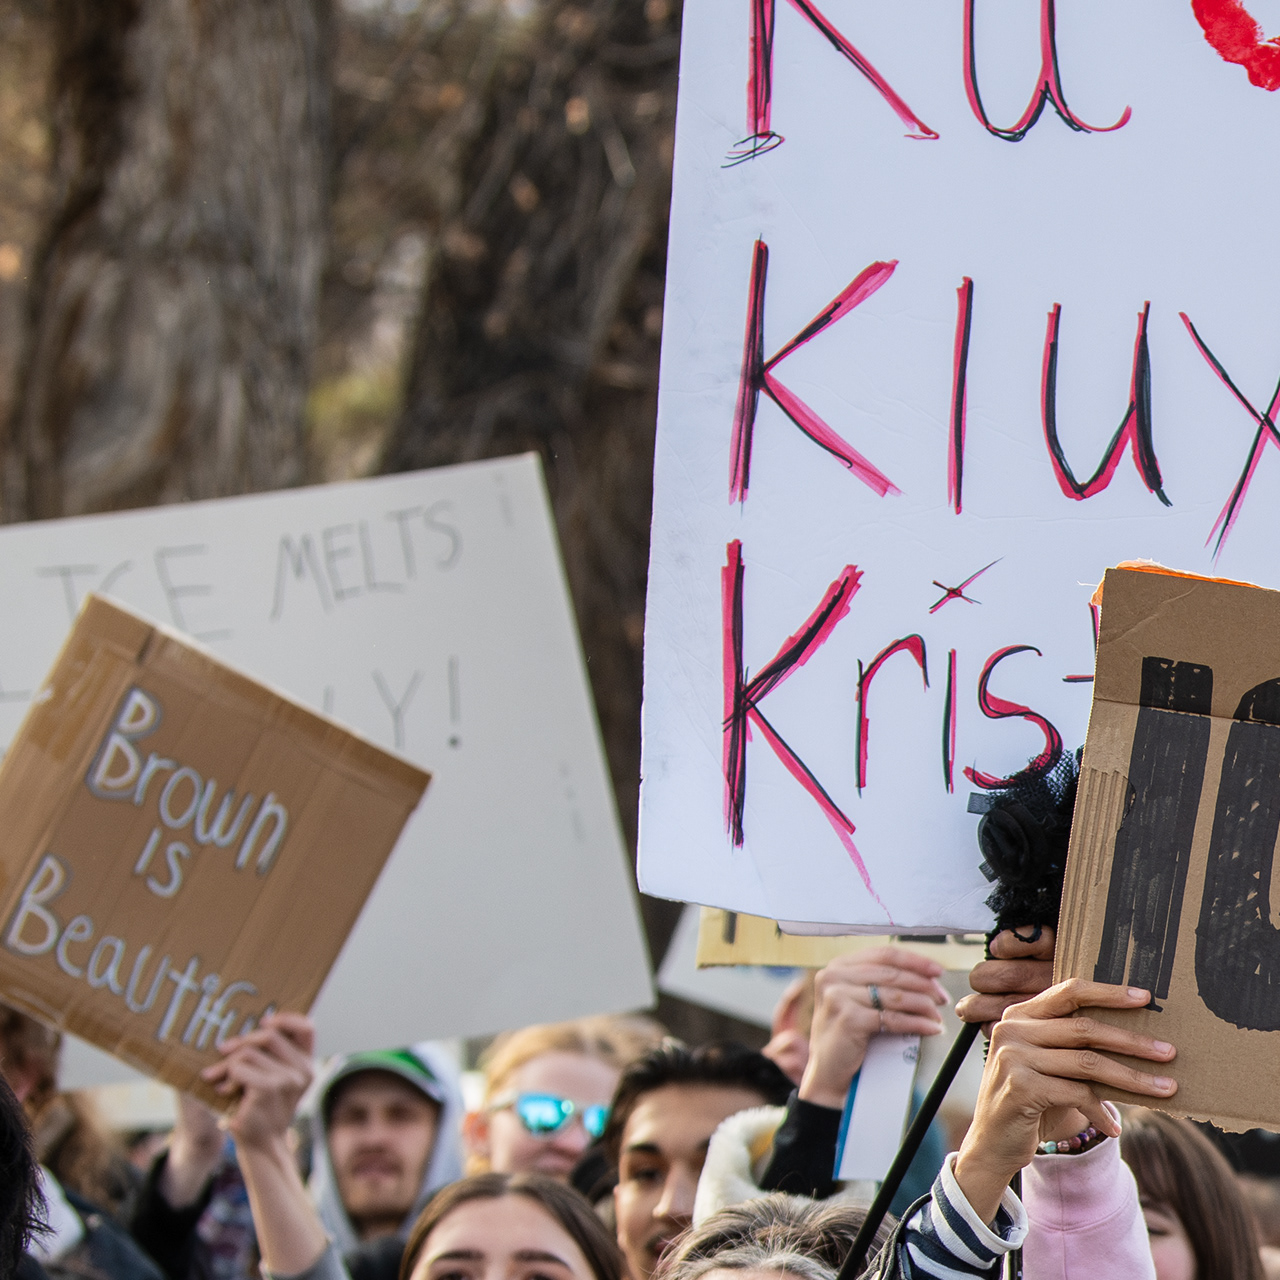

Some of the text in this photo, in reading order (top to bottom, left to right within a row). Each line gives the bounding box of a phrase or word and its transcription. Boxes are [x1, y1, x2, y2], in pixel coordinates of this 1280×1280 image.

[269, 498, 466, 624] MELTS
[85, 685, 291, 878] Brown
[720, 538, 1096, 926] Kris
[5, 852, 278, 1051] Beautifu
